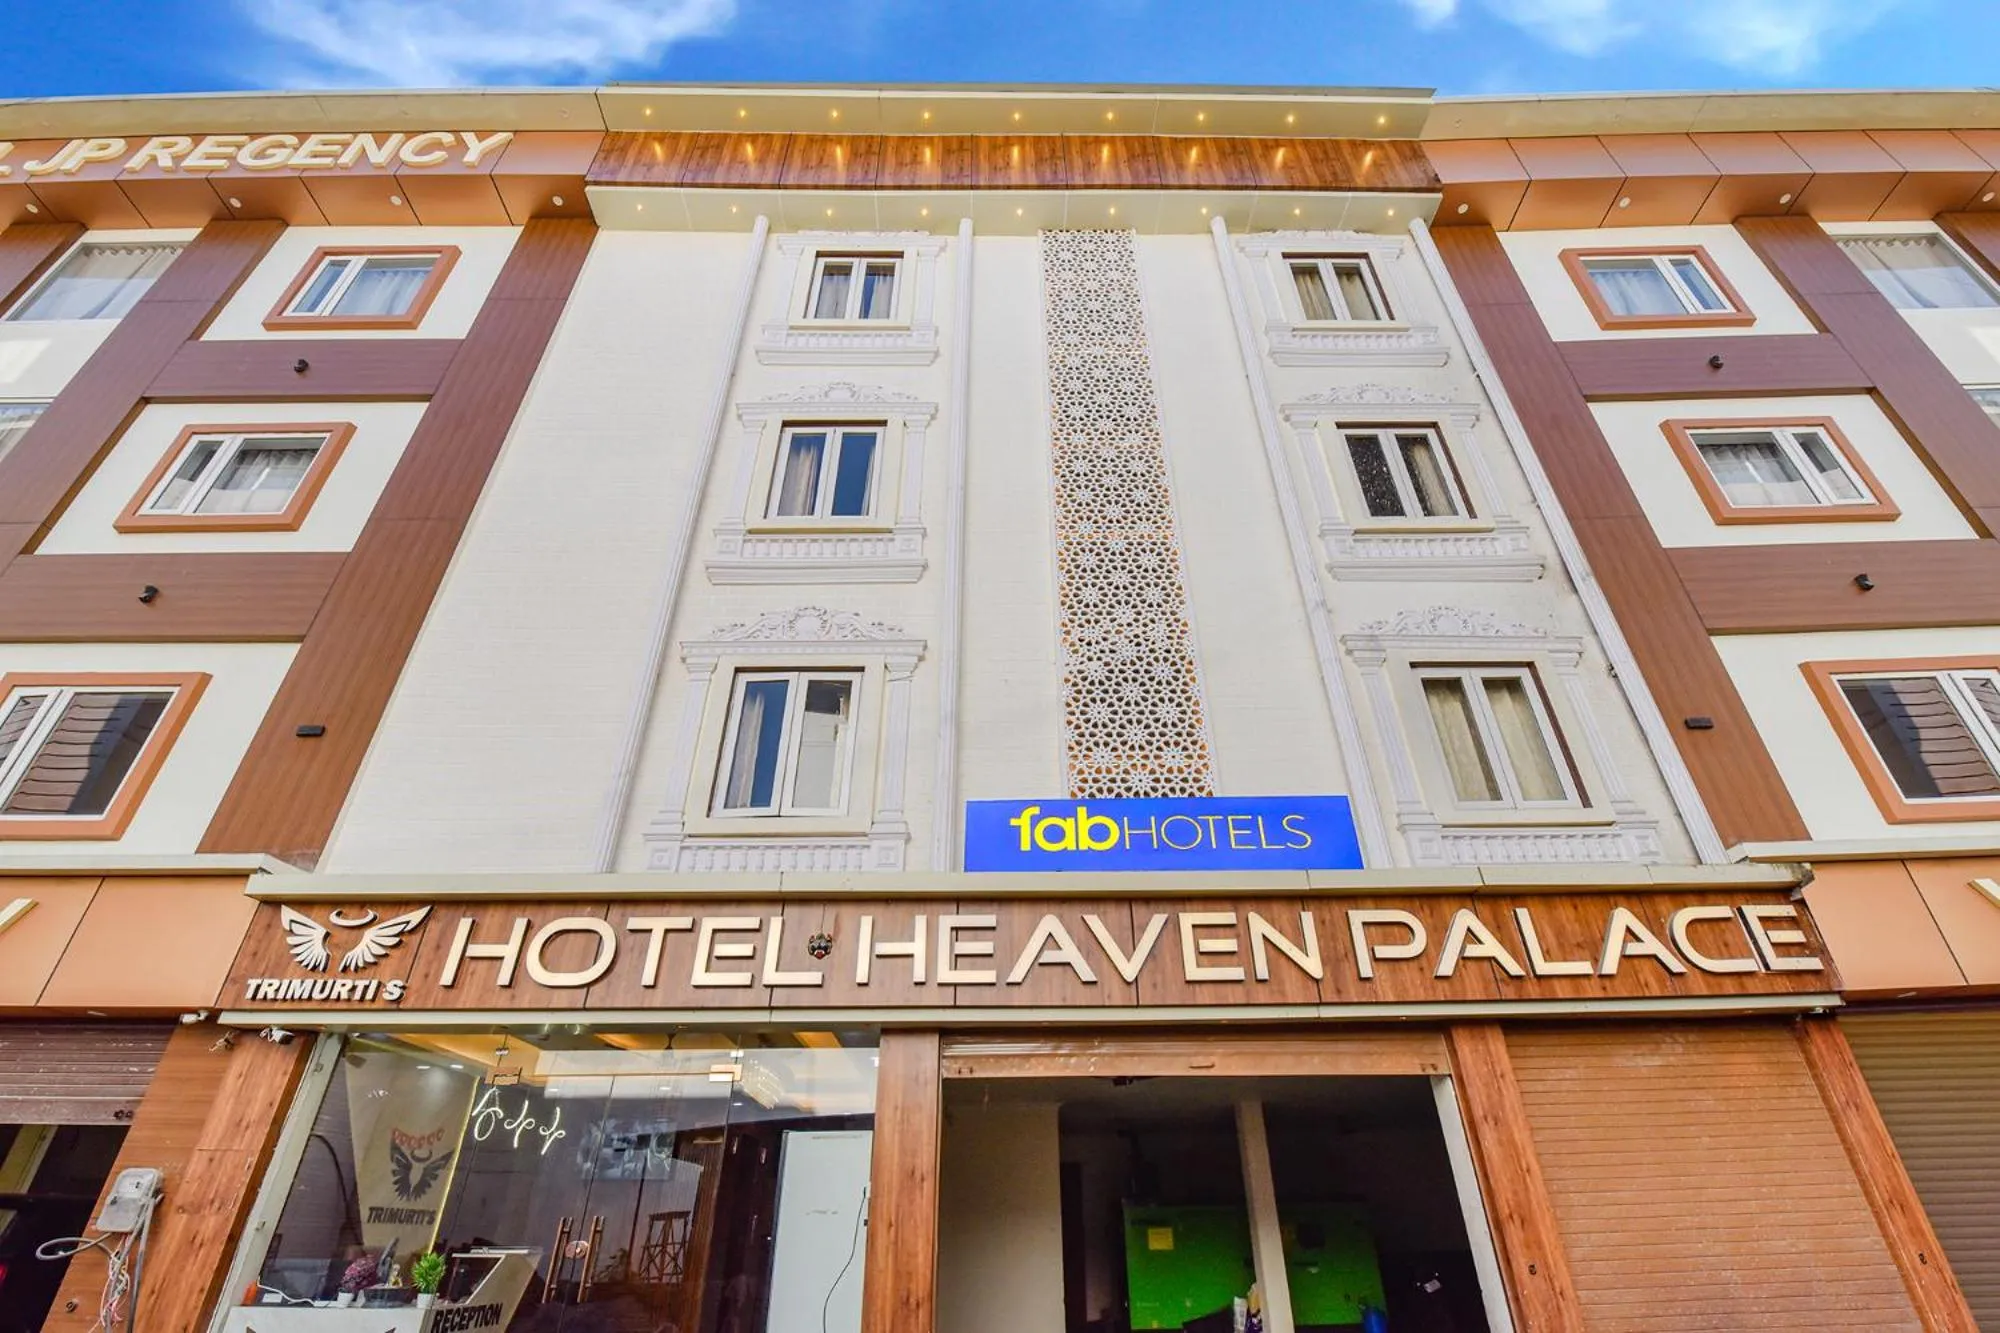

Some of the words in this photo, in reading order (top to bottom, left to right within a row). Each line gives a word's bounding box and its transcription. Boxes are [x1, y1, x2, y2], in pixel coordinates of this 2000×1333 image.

[23, 137, 128, 175] JP
[123, 132, 514, 172] REGENCY
[439, 915, 824, 987] HOTEL
[855, 911, 1324, 985] HEAVEN
[1347, 904, 1824, 978] PALACE
[431, 1303, 503, 1333] RECEPTION
